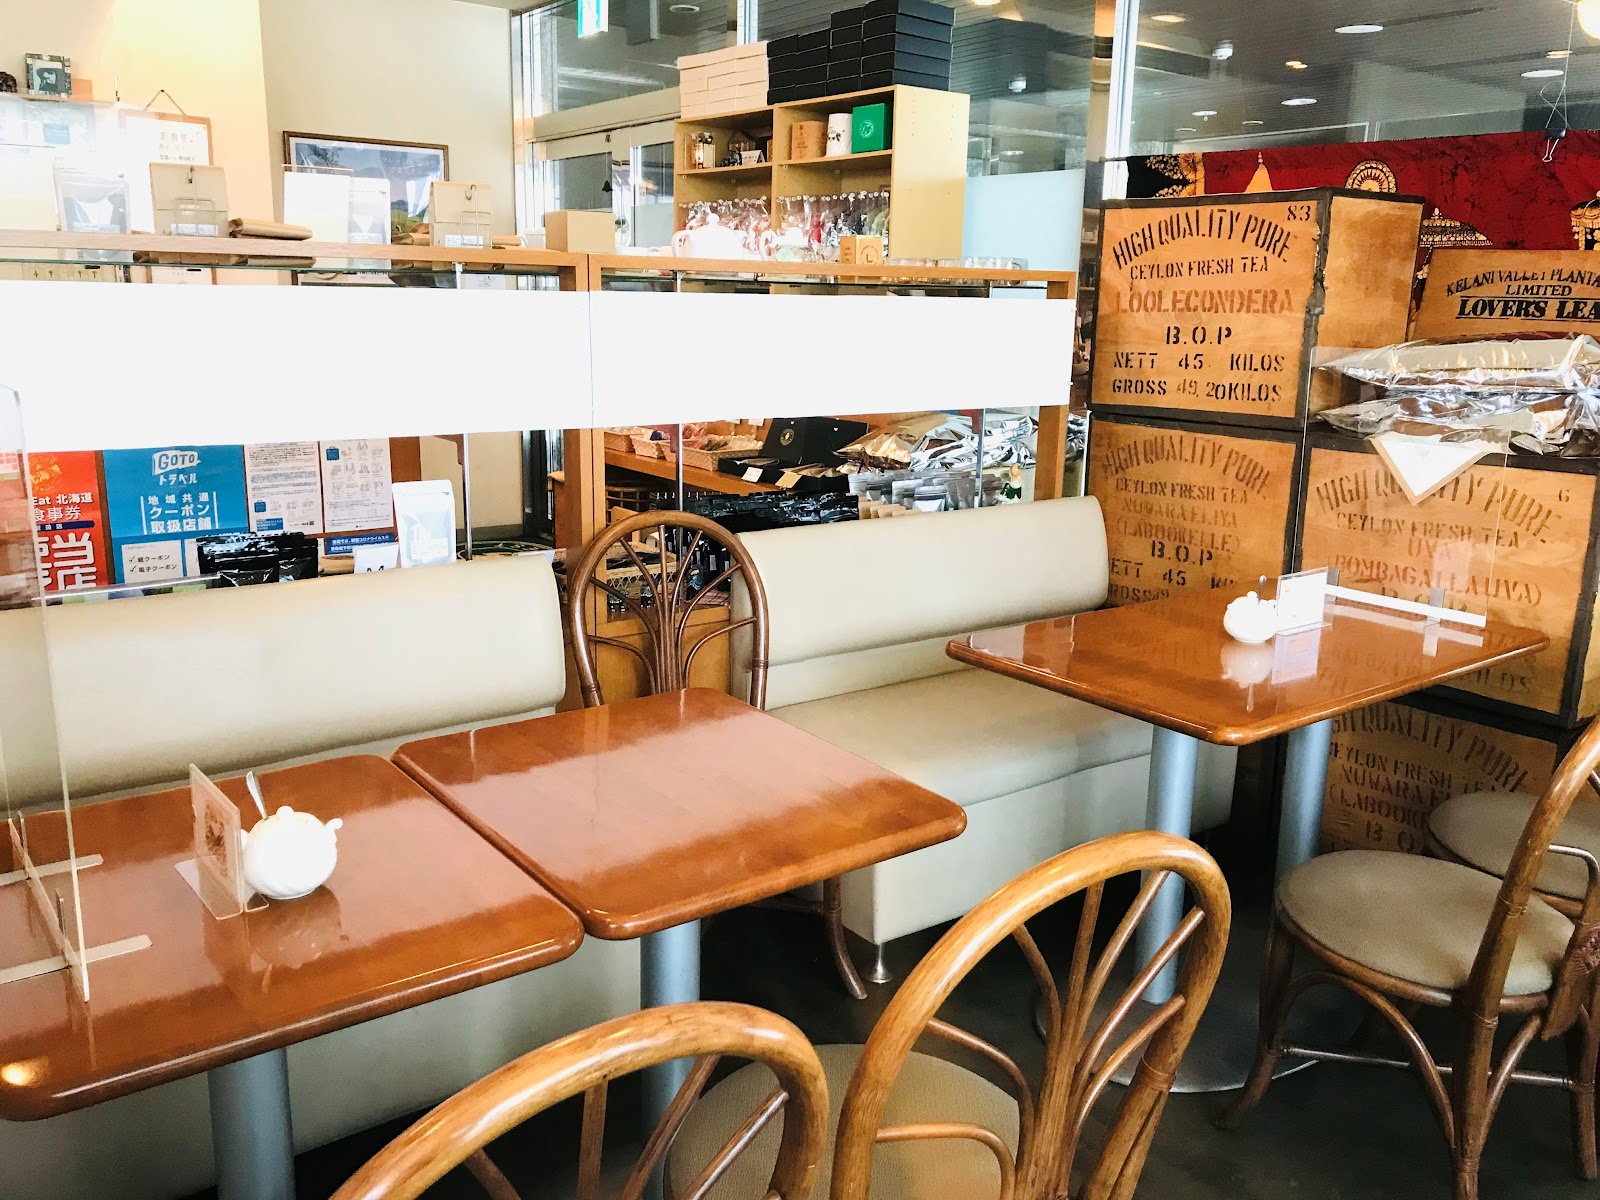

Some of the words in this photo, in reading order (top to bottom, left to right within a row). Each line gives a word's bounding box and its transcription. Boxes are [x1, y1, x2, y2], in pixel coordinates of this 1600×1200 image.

[1287, 205, 1310, 221] 83
[1112, 223, 1154, 271] HIGH
[1158, 208, 1240, 245] QUALITY
[1241, 214, 1297, 263] PURE
[1130, 263, 1184, 281] CEYLON
[1188, 258, 1234, 276] FRESH
[1241, 255, 1269, 273] TEA
[1446, 270, 1495, 298] KELANI
[1505, 284, 1573, 297] LIMITED
[1116, 288, 1294, 314] LOOLECONDERA
[1113, 351, 1158, 369] NETT
[1178, 353, 1204, 370] 45
[1230, 353, 1285, 372] KILOS
[1112, 378, 1167, 396] GROSS
[159, 473, 197, 486] トラベル
[1102, 441, 1140, 480] HIGH
[1143, 435, 1223, 467] QUALITY
[1223, 448, 1271, 500] PURE
[33, 496, 51, 505] Eat
[56, 492, 93, 504] 北海道
[148, 492, 209, 505] 地域共通
[1116, 478, 1167, 497] CEYLON
[1171, 483, 1215, 501] FRESH
[1221, 486, 1248, 504] TEA
[1558, 488, 1570, 502] 6
[34, 505, 81, 521] 食事券
[149, 504, 210, 519] クーポン
[1316, 469, 1369, 514] HIGH
[1484, 481, 1561, 544] PURE
[150, 517, 212, 534] 取扱店舗
[1336, 512, 1404, 536] CEYLON
[1411, 520, 1472, 542] FRESH
[1482, 527, 1519, 549] TEA
[1111, 558, 1143, 578] ETT
[1162, 568, 1187, 586] 45
[1361, 703, 1464, 754] QUALITY
[1464, 735, 1533, 793] PURE
[1329, 741, 1387, 772] EYLON
[1393, 760, 1452, 789] FRESH
[1341, 764, 1424, 803] NUWARA
